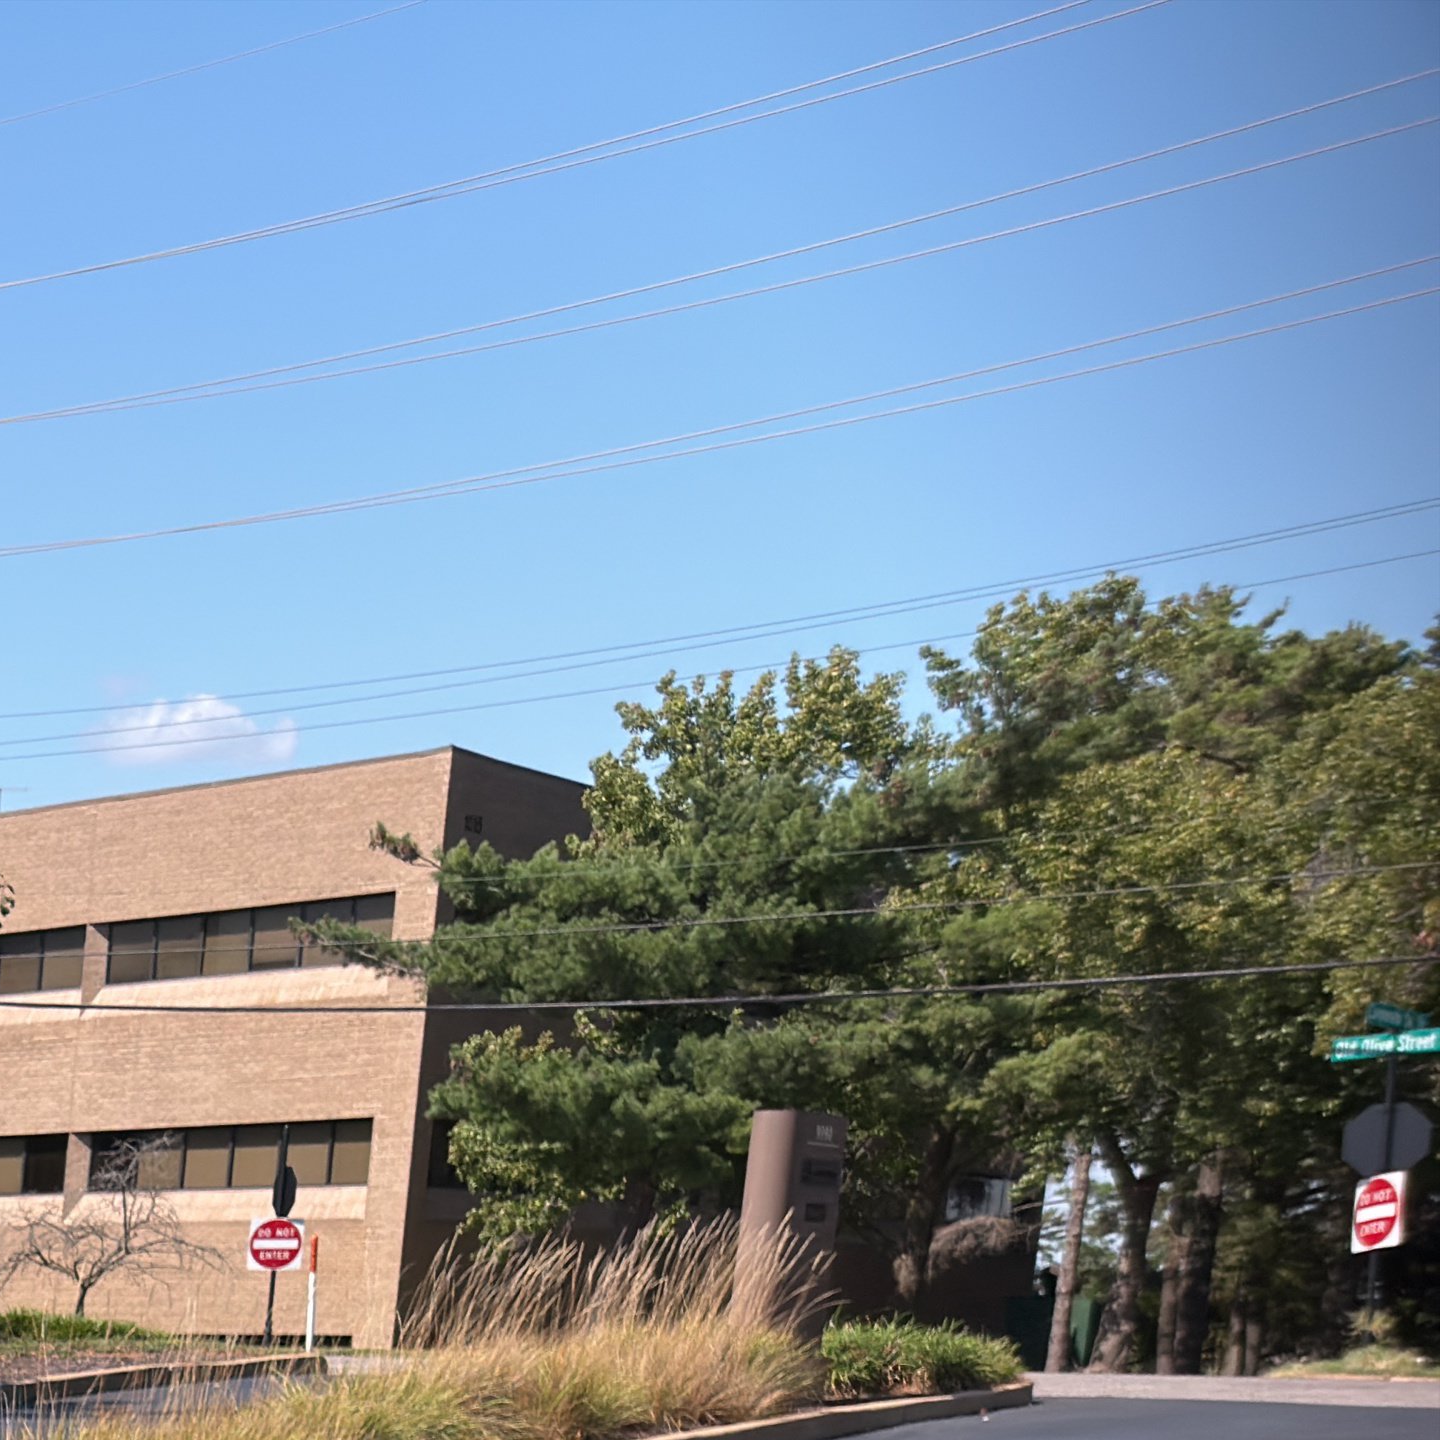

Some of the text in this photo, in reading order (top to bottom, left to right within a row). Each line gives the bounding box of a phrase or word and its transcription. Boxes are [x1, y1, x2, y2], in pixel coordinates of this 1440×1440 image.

[1396, 1033, 1437, 1053] Street
[1359, 1188, 1393, 1207] DO NOT
[257, 1227, 295, 1238] DO NOT
[1359, 1221, 1386, 1238] ENTER
[259, 1250, 290, 1260] ENTER
